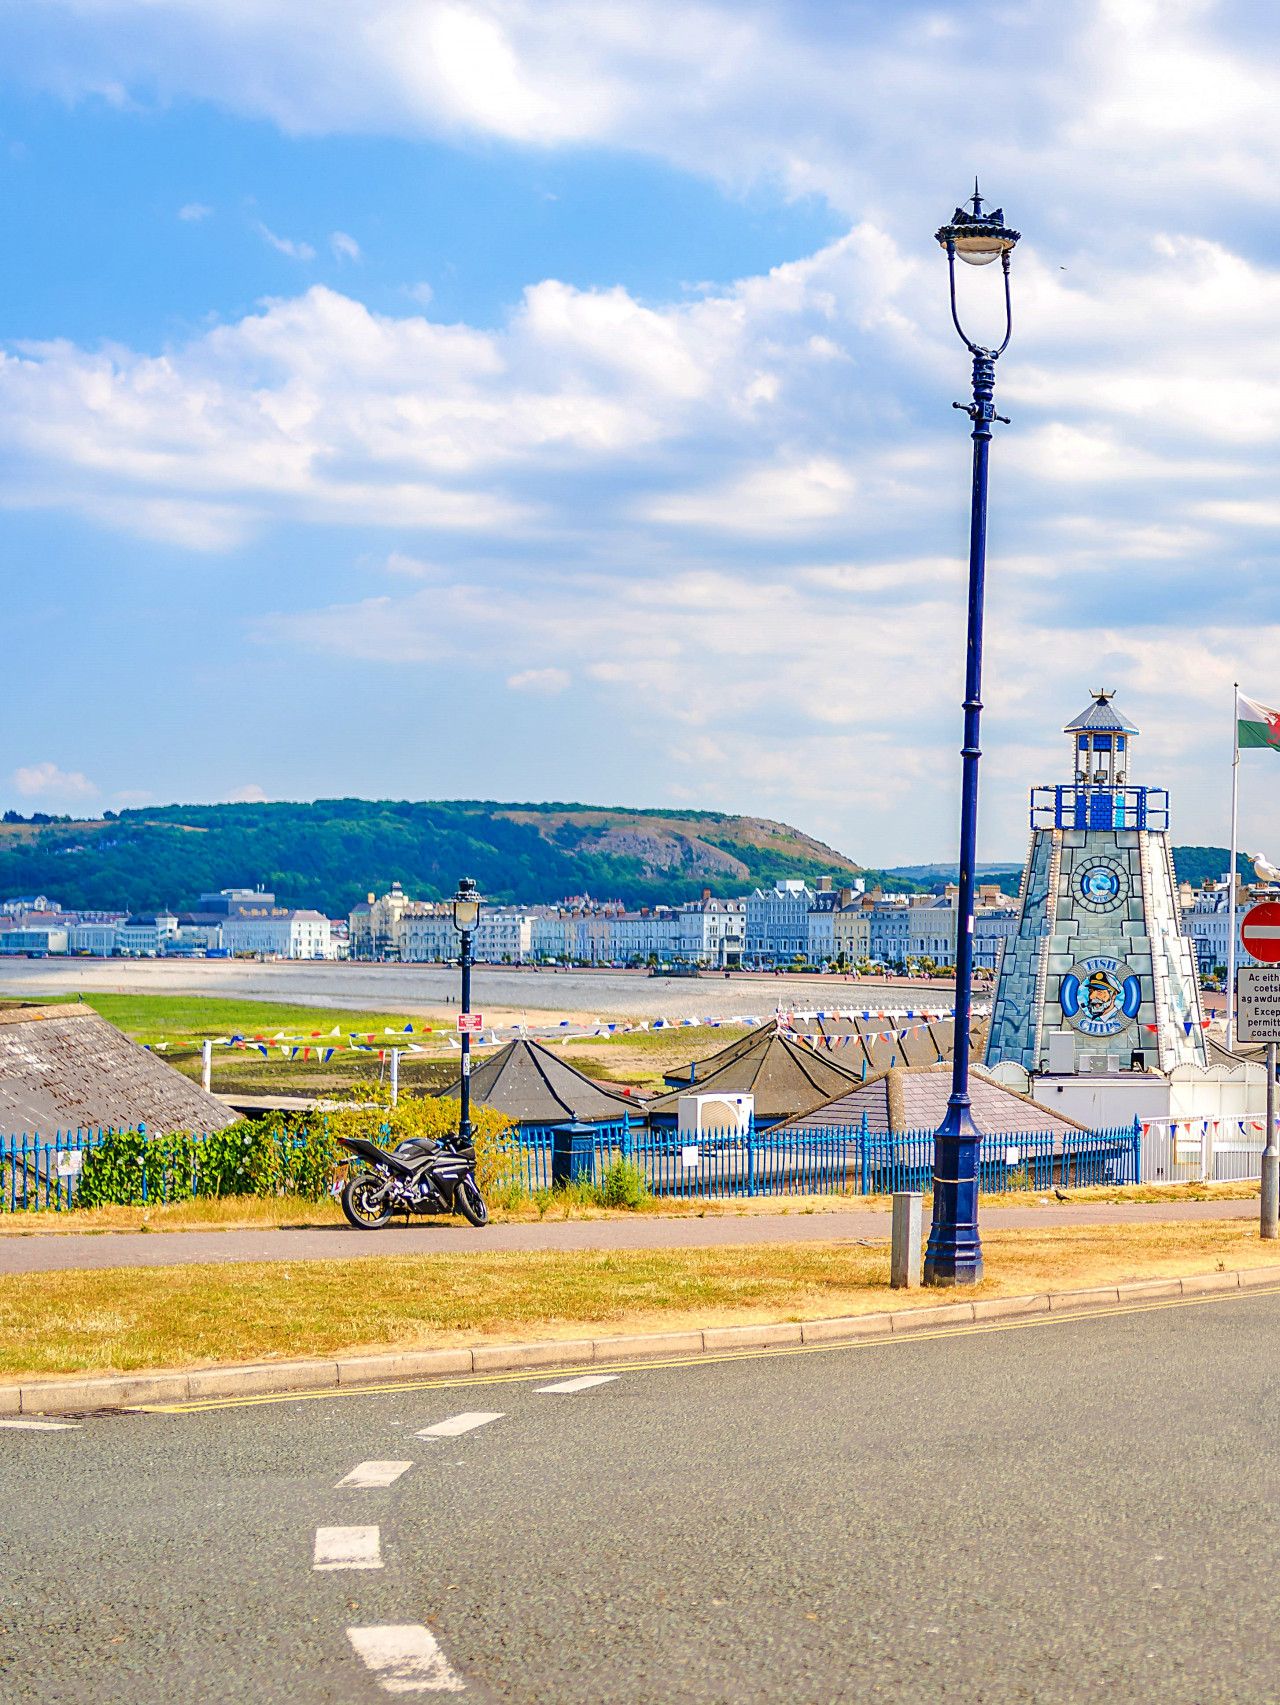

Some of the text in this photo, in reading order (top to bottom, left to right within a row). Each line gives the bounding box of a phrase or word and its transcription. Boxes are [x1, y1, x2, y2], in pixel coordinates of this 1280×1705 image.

[1086, 959, 1117, 971] FISH
[1248, 974, 1260, 982] Ac
[1241, 996, 1252, 1004] ag
[1079, 1019, 1122, 1033] CHIPS
